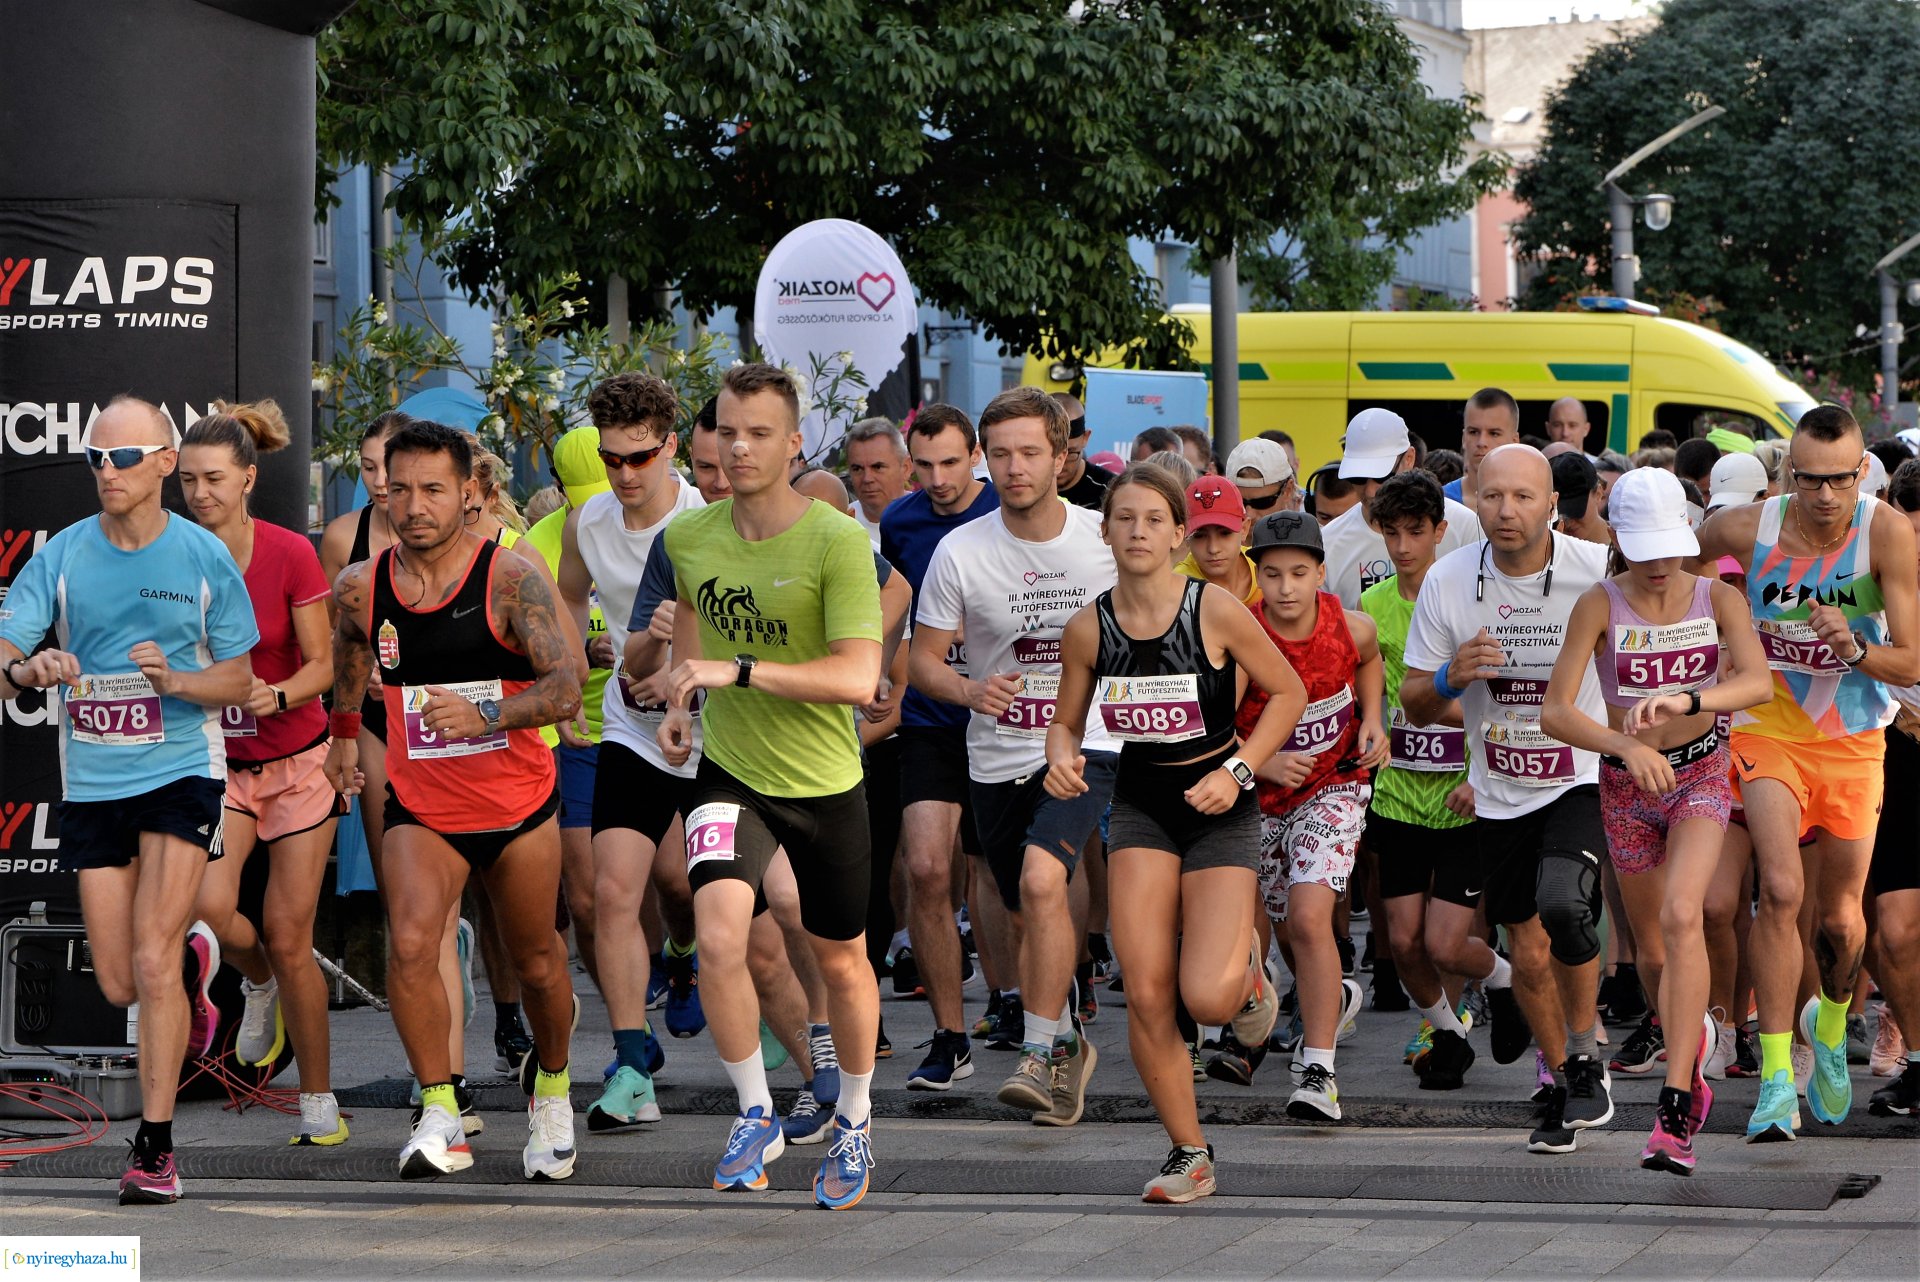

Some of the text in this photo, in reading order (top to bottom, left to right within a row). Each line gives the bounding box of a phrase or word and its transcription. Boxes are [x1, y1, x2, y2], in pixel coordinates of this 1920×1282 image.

[0, 312, 208, 329] SPORTS TIMING
[1038, 572, 1066, 580] MOZAIK
[1008, 586, 1087, 602] III. NYÍREGYHÁZI
[1762, 582, 1858, 609] BERLIN
[1011, 598, 1085, 614] FUTÓFESZTIVÁL
[720, 616, 788, 635] DRAGON
[1496, 623, 1562, 635] NYÍREGYHÁZI
[728, 629, 788, 646] RACE
[1658, 630, 1709, 644] FUTÓFESZTIVÁL
[1036, 642, 1060, 651] ÉN IS
[1771, 637, 1836, 665] 5072
[1020, 652, 1061, 662] LEFUTOT
[1630, 652, 1706, 684] 5142
[1137, 687, 1190, 695] FUTÓFESZTIVÁL
[1511, 681, 1537, 691] ÉN IS
[79, 703, 149, 731] 5078
[1114, 706, 1188, 731] 5089
[1295, 715, 1339, 746] 504
[1405, 733, 1445, 758] 526
[1494, 748, 1560, 775] 5057
[1304, 822, 1331, 839] BULLS
